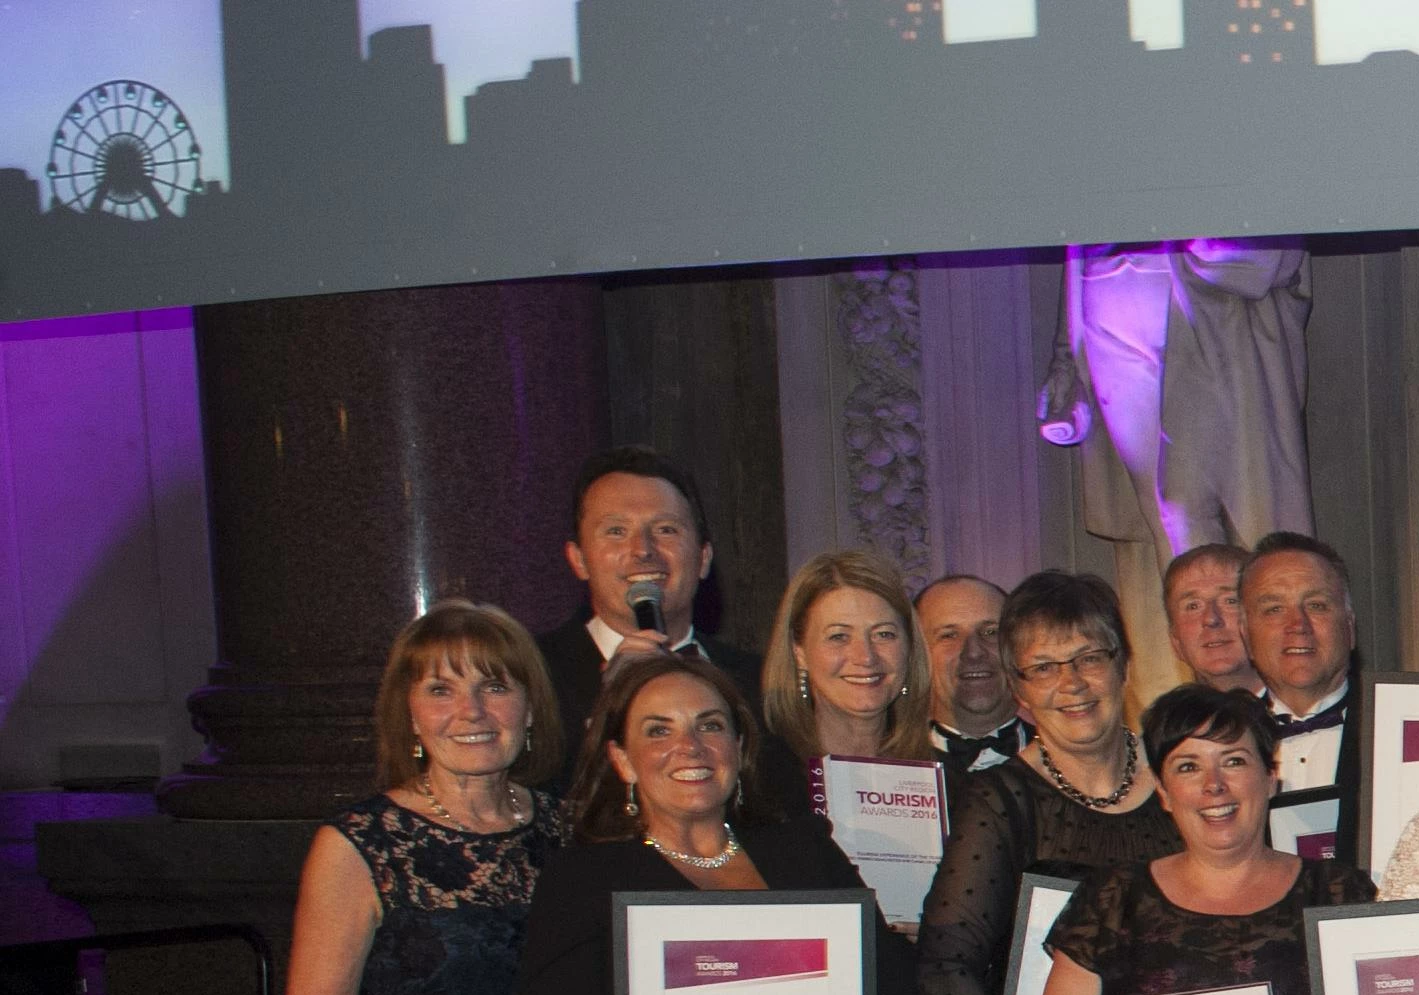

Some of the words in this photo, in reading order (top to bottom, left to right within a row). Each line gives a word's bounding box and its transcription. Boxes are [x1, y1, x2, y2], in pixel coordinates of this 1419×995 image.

[811, 767, 826, 816] 2016
[856, 791, 937, 808] TOURISM
[860, 806, 909, 818] AWARDS
[911, 810, 937, 819] 2016
[696, 962, 738, 971] TOURISM
[1375, 978, 1414, 989] TOURISM
